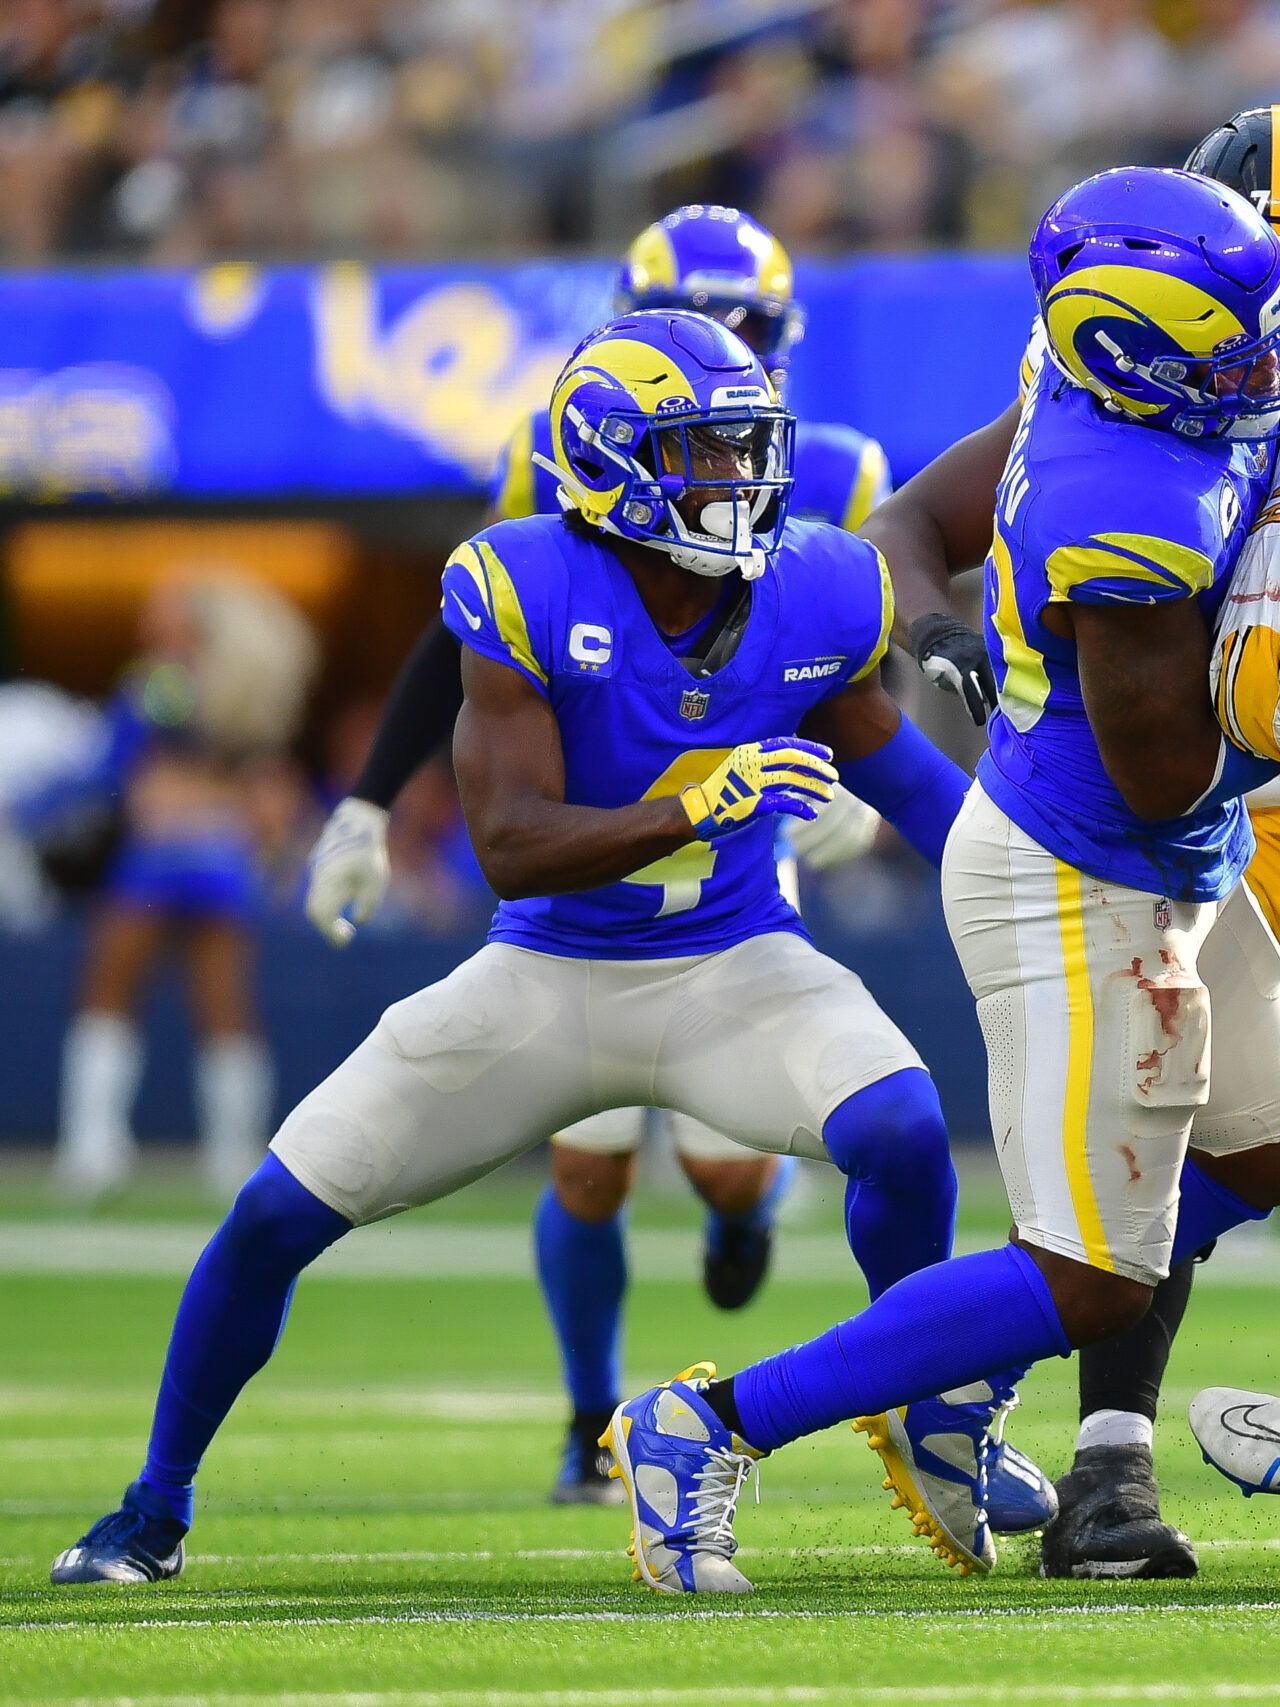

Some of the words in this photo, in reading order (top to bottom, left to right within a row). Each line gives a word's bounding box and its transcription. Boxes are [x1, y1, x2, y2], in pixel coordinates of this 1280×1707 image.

[568, 622, 613, 665] C
[783, 661, 842, 683] RAMS
[620, 748, 735, 919] 4
